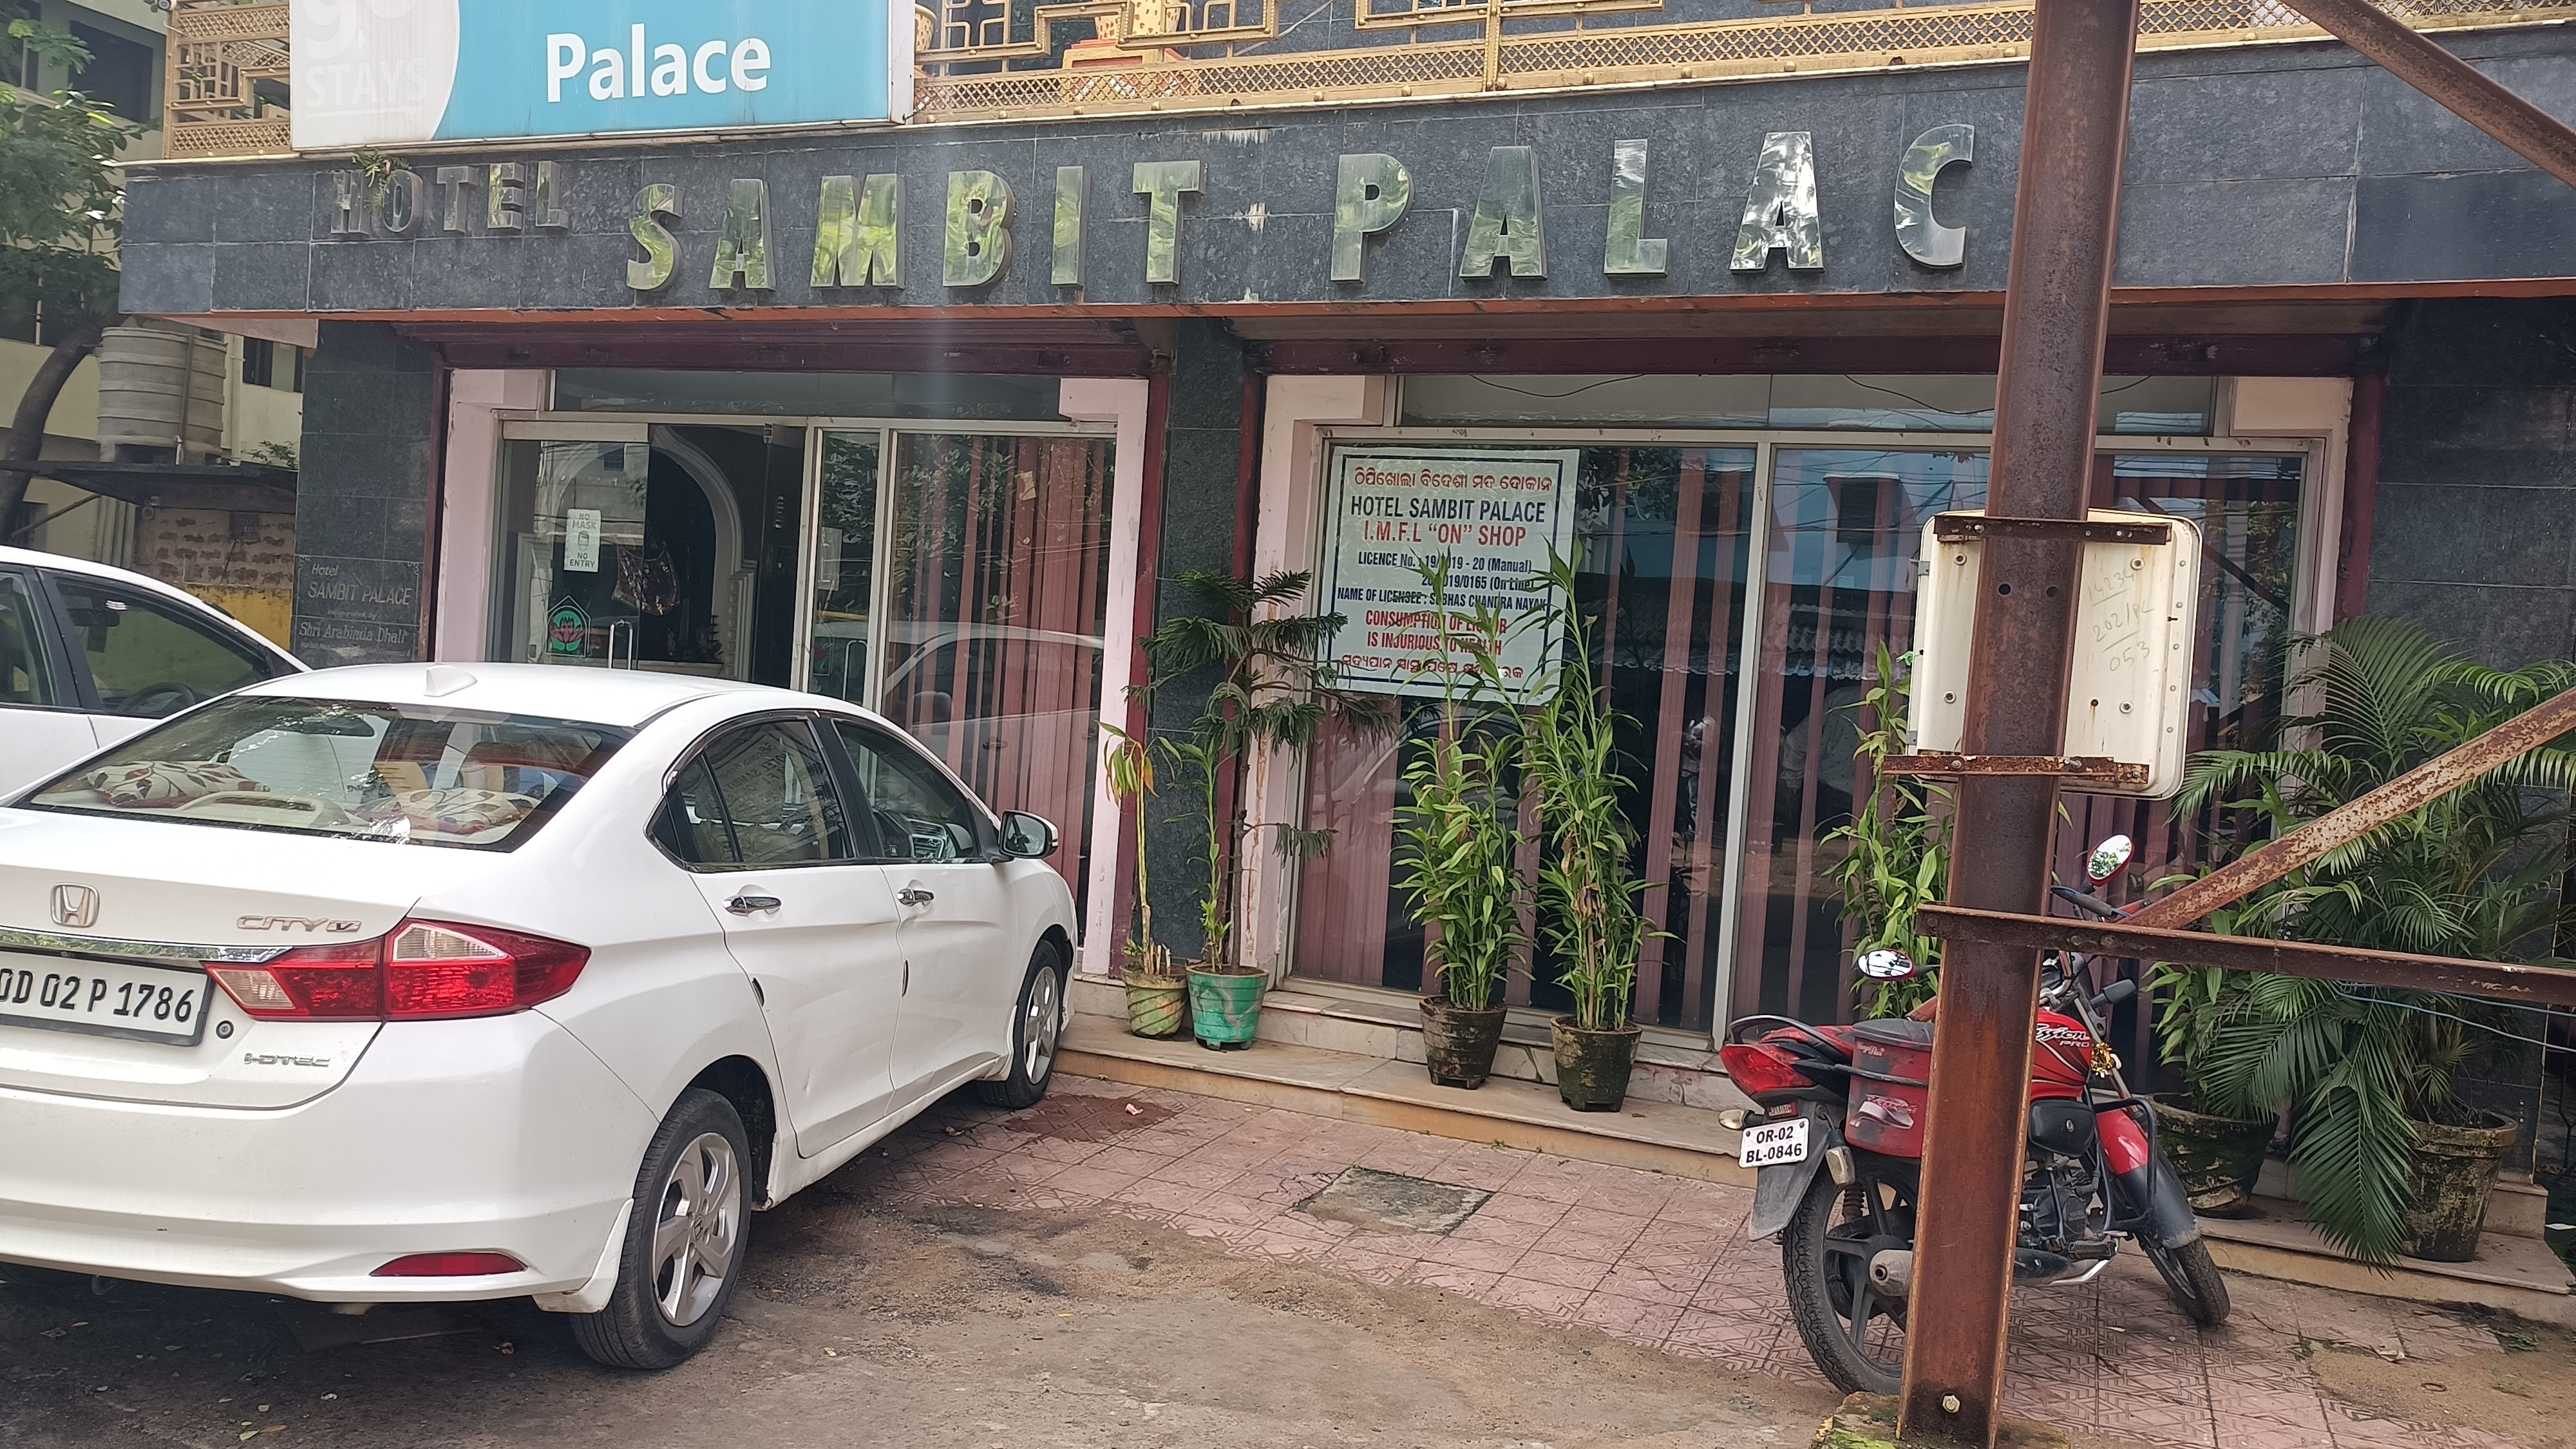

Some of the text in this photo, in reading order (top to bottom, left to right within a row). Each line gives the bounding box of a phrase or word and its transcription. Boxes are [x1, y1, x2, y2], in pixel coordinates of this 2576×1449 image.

[547, 23, 771, 103] Palace
[305, 58, 427, 108] STAYS
[330, 124, 1975, 291] HOTEL SAMBIT PALAC
[1351, 496, 1546, 523] HOTEL SAMBIT PALACE
[572, 520, 596, 529] MASK
[1478, 526, 1526, 547] SHOP
[311, 563, 339, 576] Hotel
[569, 559, 596, 568] ENTRY
[1358, 551, 1399, 566] LICENCE
[1400, 553, 1416, 567] No.
[1473, 557, 1484, 571] 20
[1488, 558, 1532, 574] (Manual)
[308, 582, 412, 605] SAMBIT PALACE
[1338, 587, 1363, 601] NAME
[1366, 589, 1377, 601] OF
[1379, 589, 1422, 604] LICENSEE
[1430, 592, 1466, 607] SBHAS
[299, 621, 321, 638] Shri
[323, 624, 373, 641] Arabinda
[1450, 616, 1463, 631] OF
[1466, 616, 1507, 634] LIQR
[1367, 631, 1378, 648] IS
[1381, 632, 1440, 650] INJURIOUS
[1445, 637, 1456, 652] TO
[236, 915, 328, 932] CITY
[40, 973, 81, 1010] 02
[87, 978, 107, 1012] P
[113, 982, 194, 1023] 1786
[1756, 1126, 1794, 1144] OR-02
[1746, 1143, 1802, 1163] BL-0846
